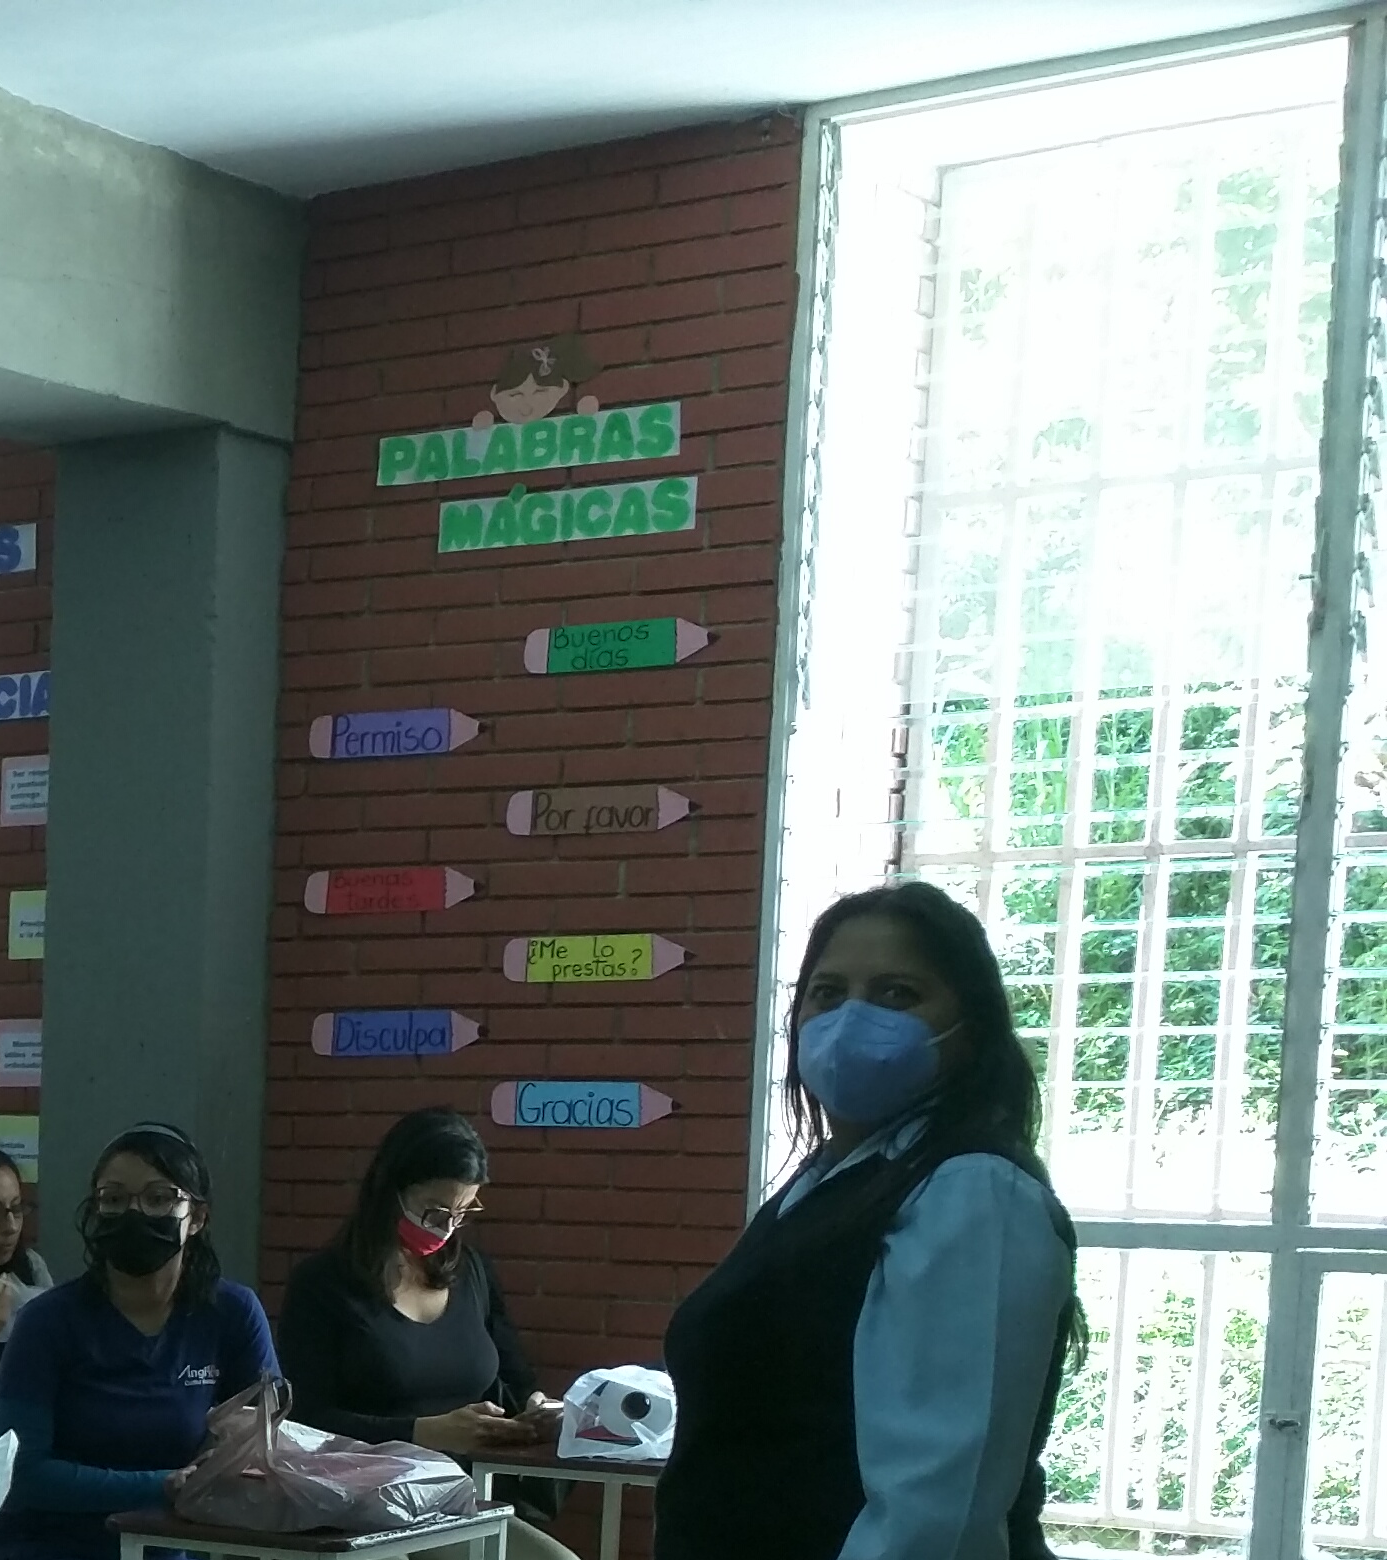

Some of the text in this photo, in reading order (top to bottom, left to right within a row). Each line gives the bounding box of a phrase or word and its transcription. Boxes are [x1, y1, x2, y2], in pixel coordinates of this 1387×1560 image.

[380, 403, 676, 486] PALABRAS
[440, 477, 692, 550] MÁGICAS
[553, 623, 650, 649] Buenos
[571, 644, 629, 670] días
[332, 713, 445, 757] Permiso
[532, 790, 656, 835] Por favor
[334, 1013, 448, 1063] Disculpa
[516, 1081, 634, 1128] Gracias
